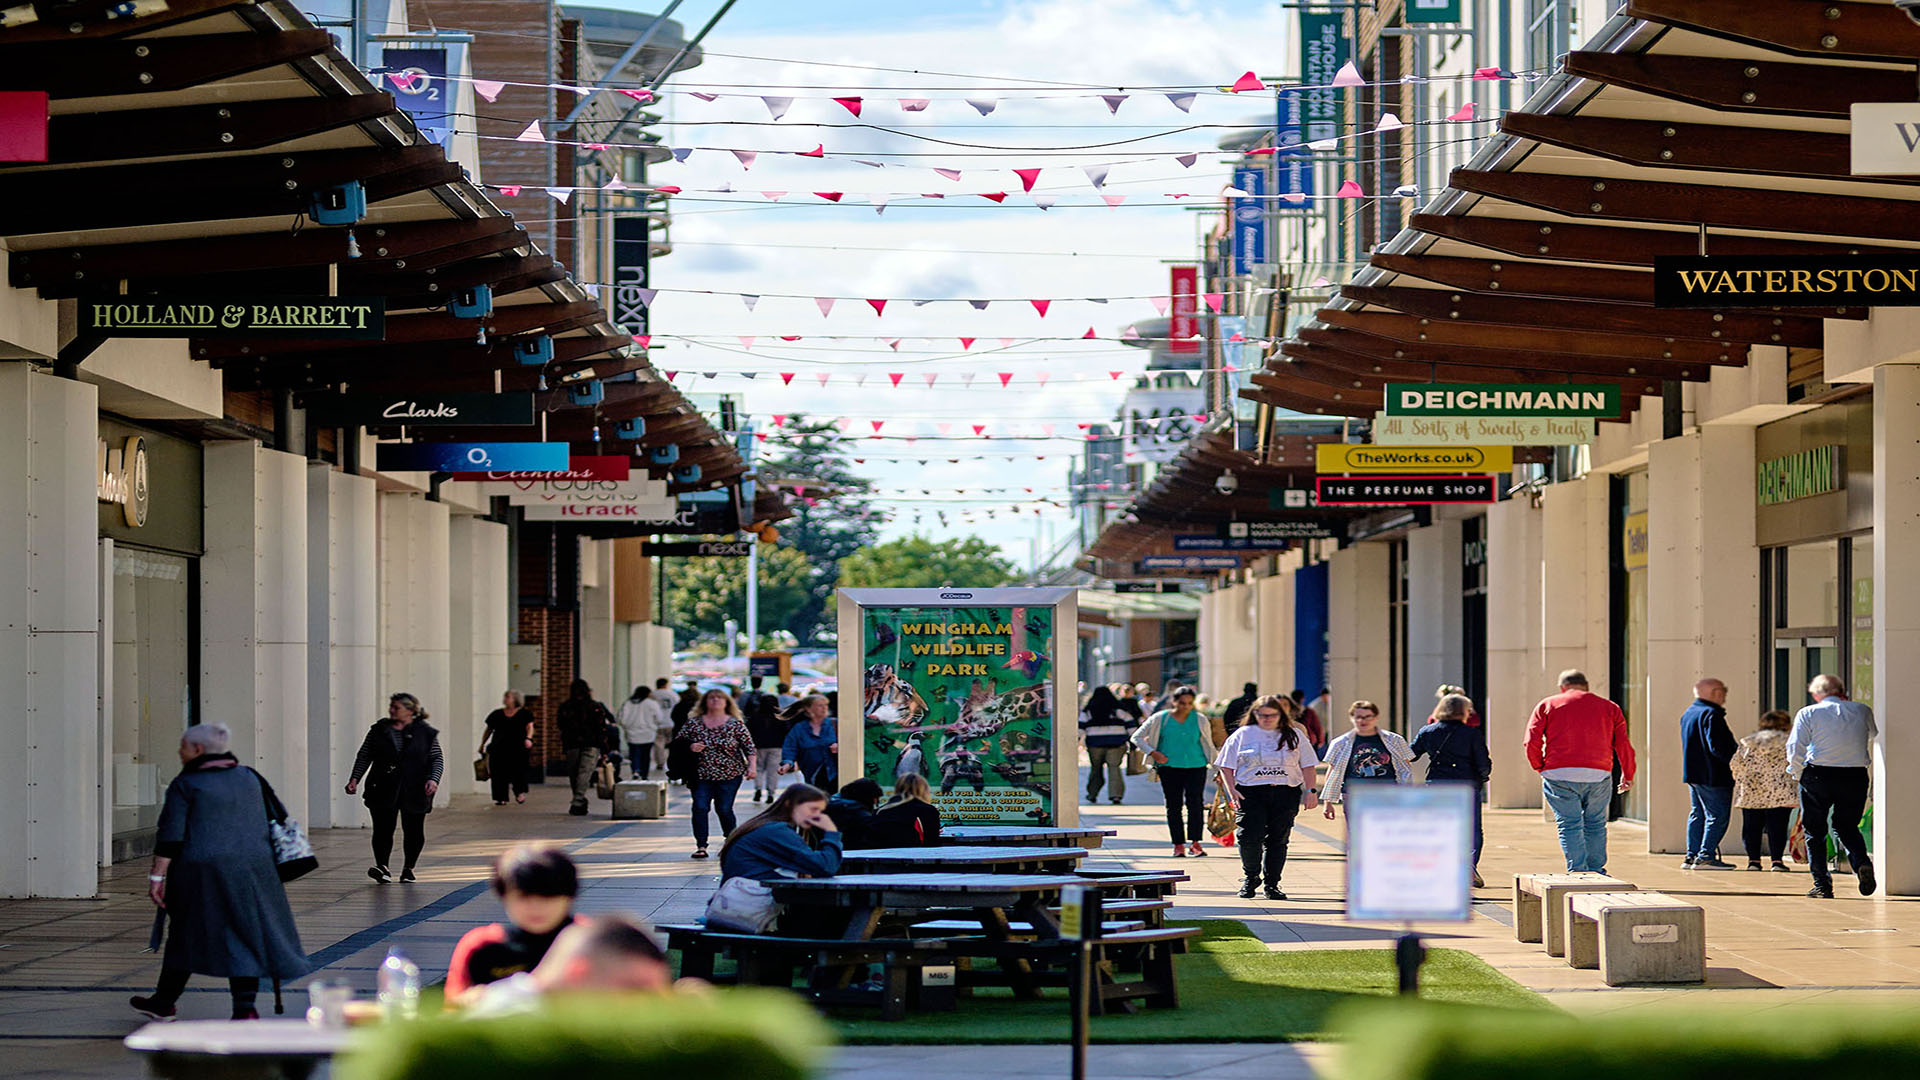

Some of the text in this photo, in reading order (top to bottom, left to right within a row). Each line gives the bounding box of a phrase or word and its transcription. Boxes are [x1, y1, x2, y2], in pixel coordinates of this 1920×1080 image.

[1677, 269, 1919, 293] WATERSTON
[92, 304, 372, 328] HOLLAND & BARRETT
[1400, 391, 1605, 410] DEICHMANN
[383, 401, 458, 418] Clarks
[1384, 418, 1403, 436] All
[1411, 418, 1450, 442] Sorts
[1455, 420, 1470, 440] of
[1478, 418, 1525, 442] Sweets
[1545, 417, 1587, 441] Treats
[467, 448, 492, 467] O2
[1356, 452, 1475, 464] TheWorks.co.uk
[1758, 444, 1832, 505] DEICHMANN
[1327, 485, 1486, 495] THE PERFUME SHOP
[699, 543, 748, 554] next
[902, 623, 1013, 635] WINGHAM
[911, 643, 1005, 655] WILDLIFE
[928, 664, 988, 675] PARK
